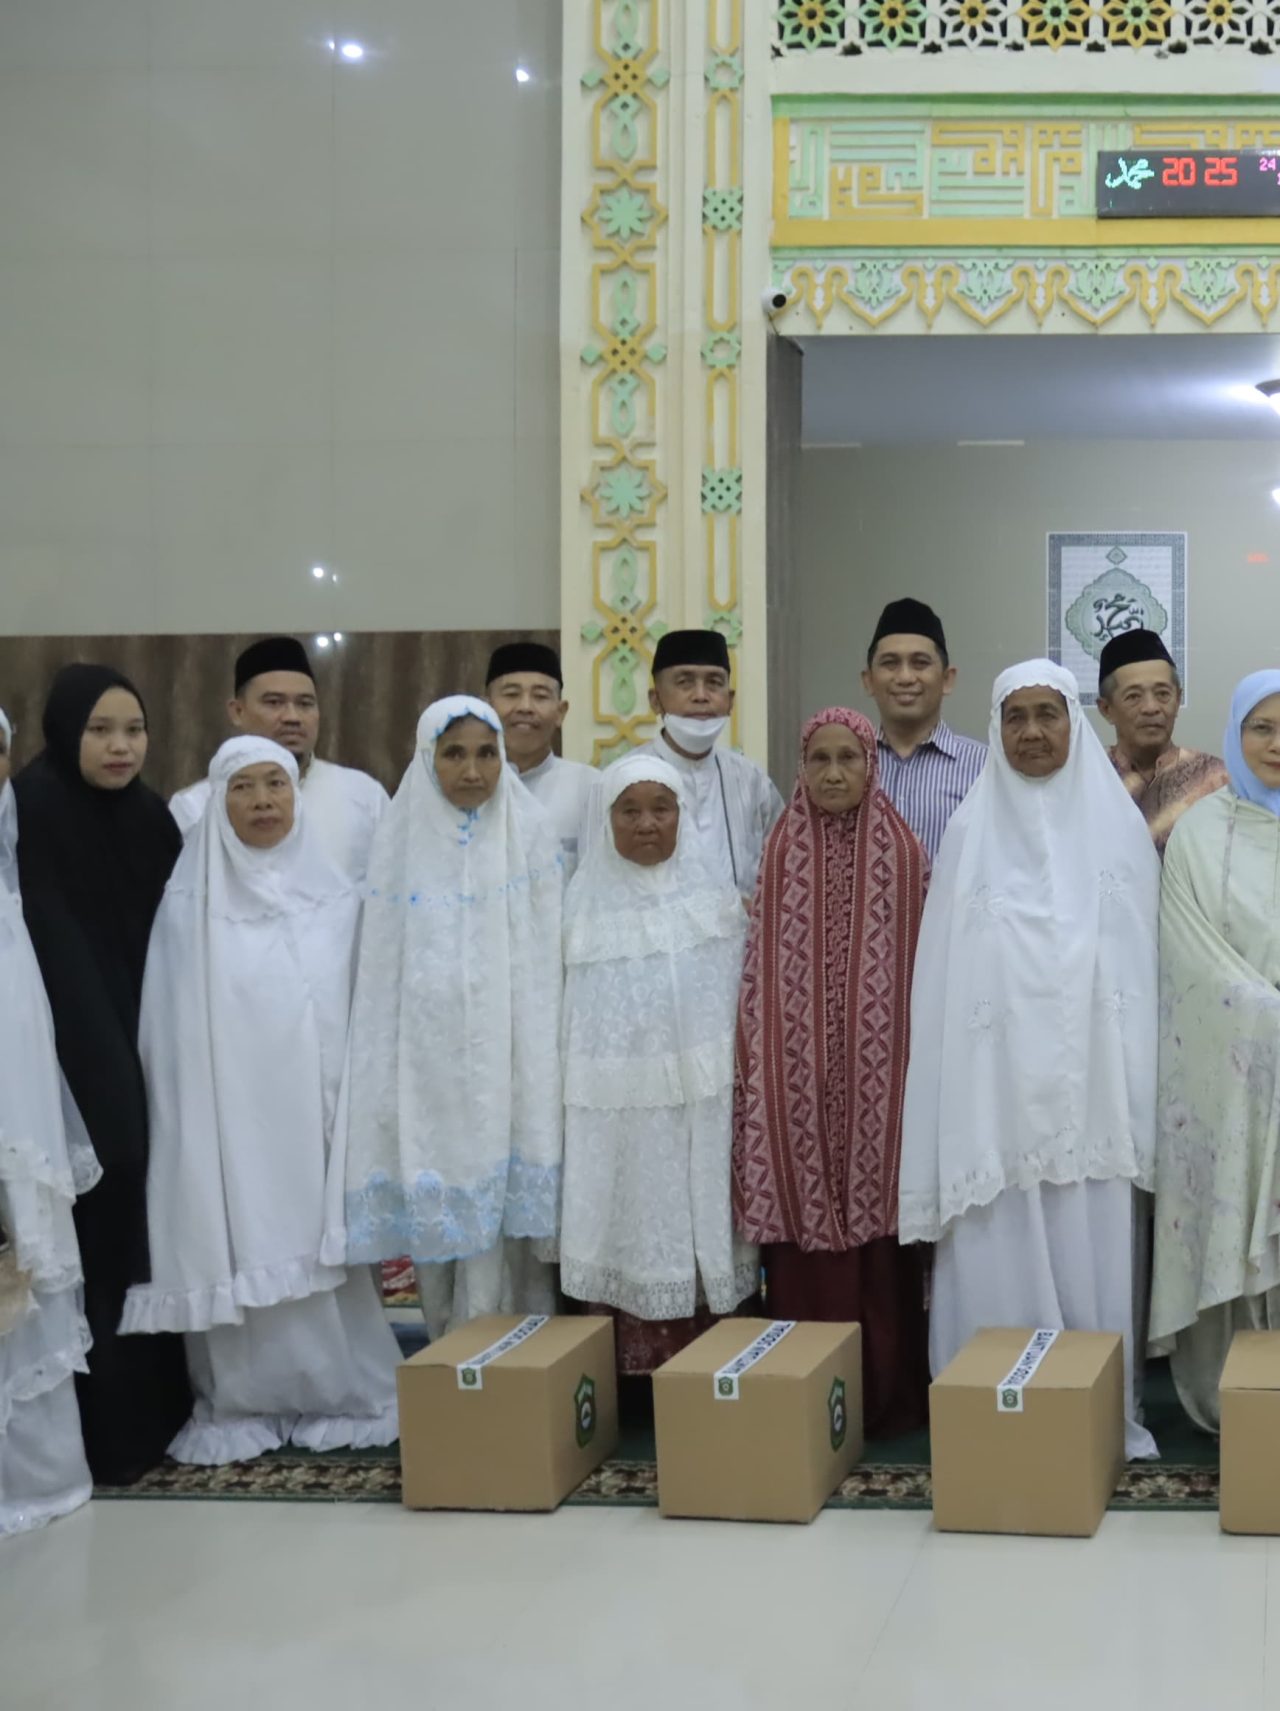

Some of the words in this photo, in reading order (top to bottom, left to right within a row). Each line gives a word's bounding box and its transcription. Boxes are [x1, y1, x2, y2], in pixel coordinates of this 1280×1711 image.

[1162, 157, 1196, 186] 20
[1204, 157, 1238, 186] 25
[1259, 157, 1276, 171] 24
[1018, 1331, 1054, 1366] BANTUAN
